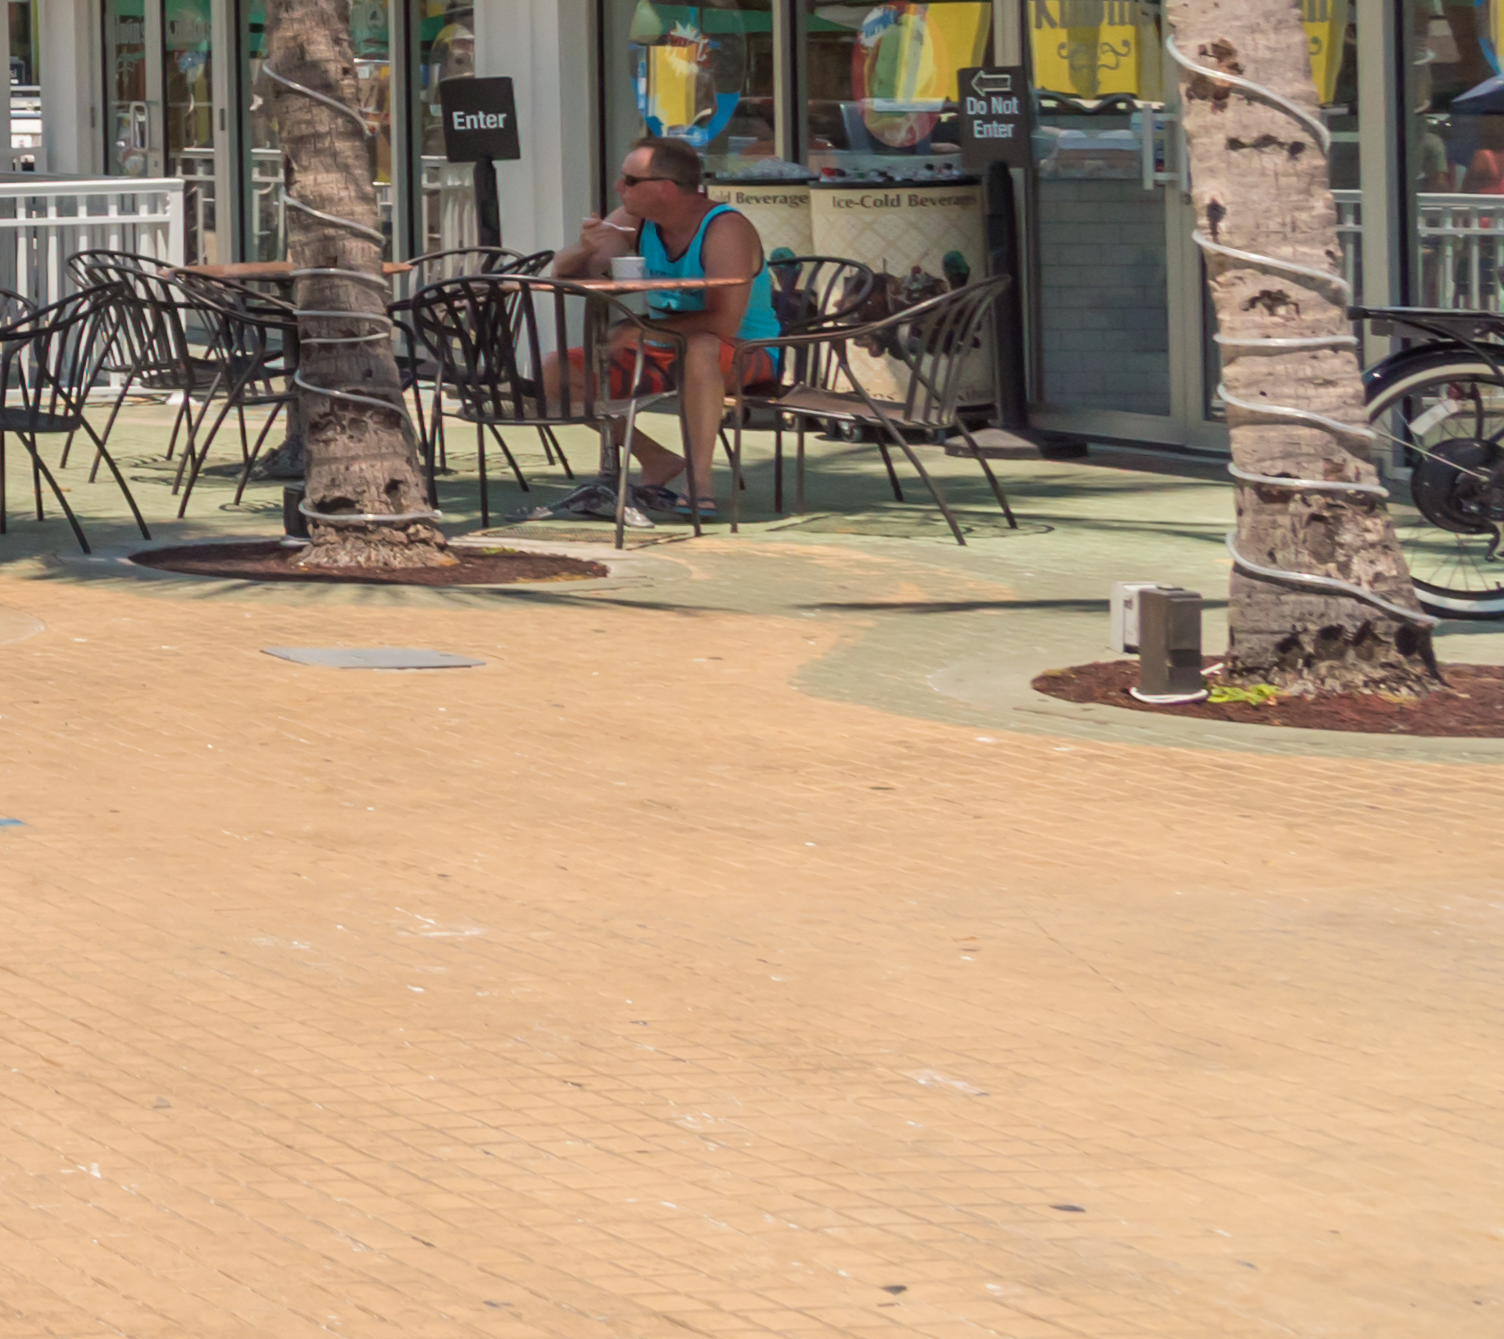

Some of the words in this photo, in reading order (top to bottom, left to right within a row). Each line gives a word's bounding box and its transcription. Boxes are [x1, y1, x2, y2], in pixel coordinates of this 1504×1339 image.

[966, 97, 986, 114] Do
[989, 97, 1019, 114] Not
[452, 109, 507, 130] Enter
[973, 120, 1014, 138] Enter
[831, 194, 900, 209] Ice-Cold
